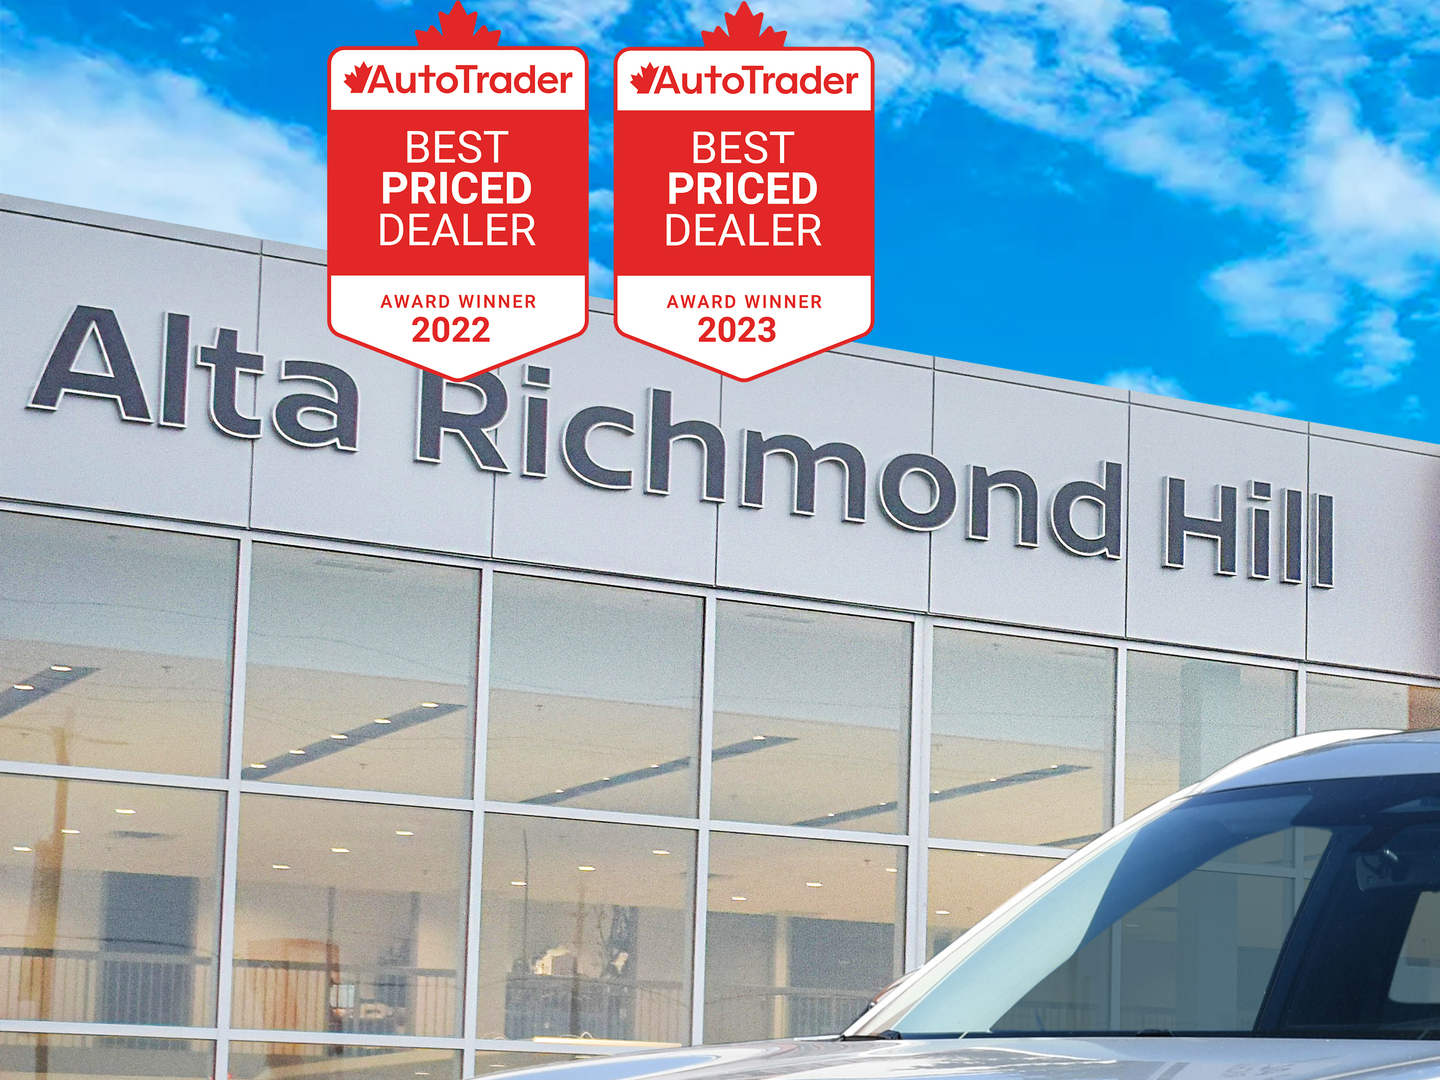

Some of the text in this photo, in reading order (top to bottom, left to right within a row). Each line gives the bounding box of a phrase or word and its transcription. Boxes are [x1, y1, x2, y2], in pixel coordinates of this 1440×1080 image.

[25, 304, 1335, 589] Alta Richmond Hill
